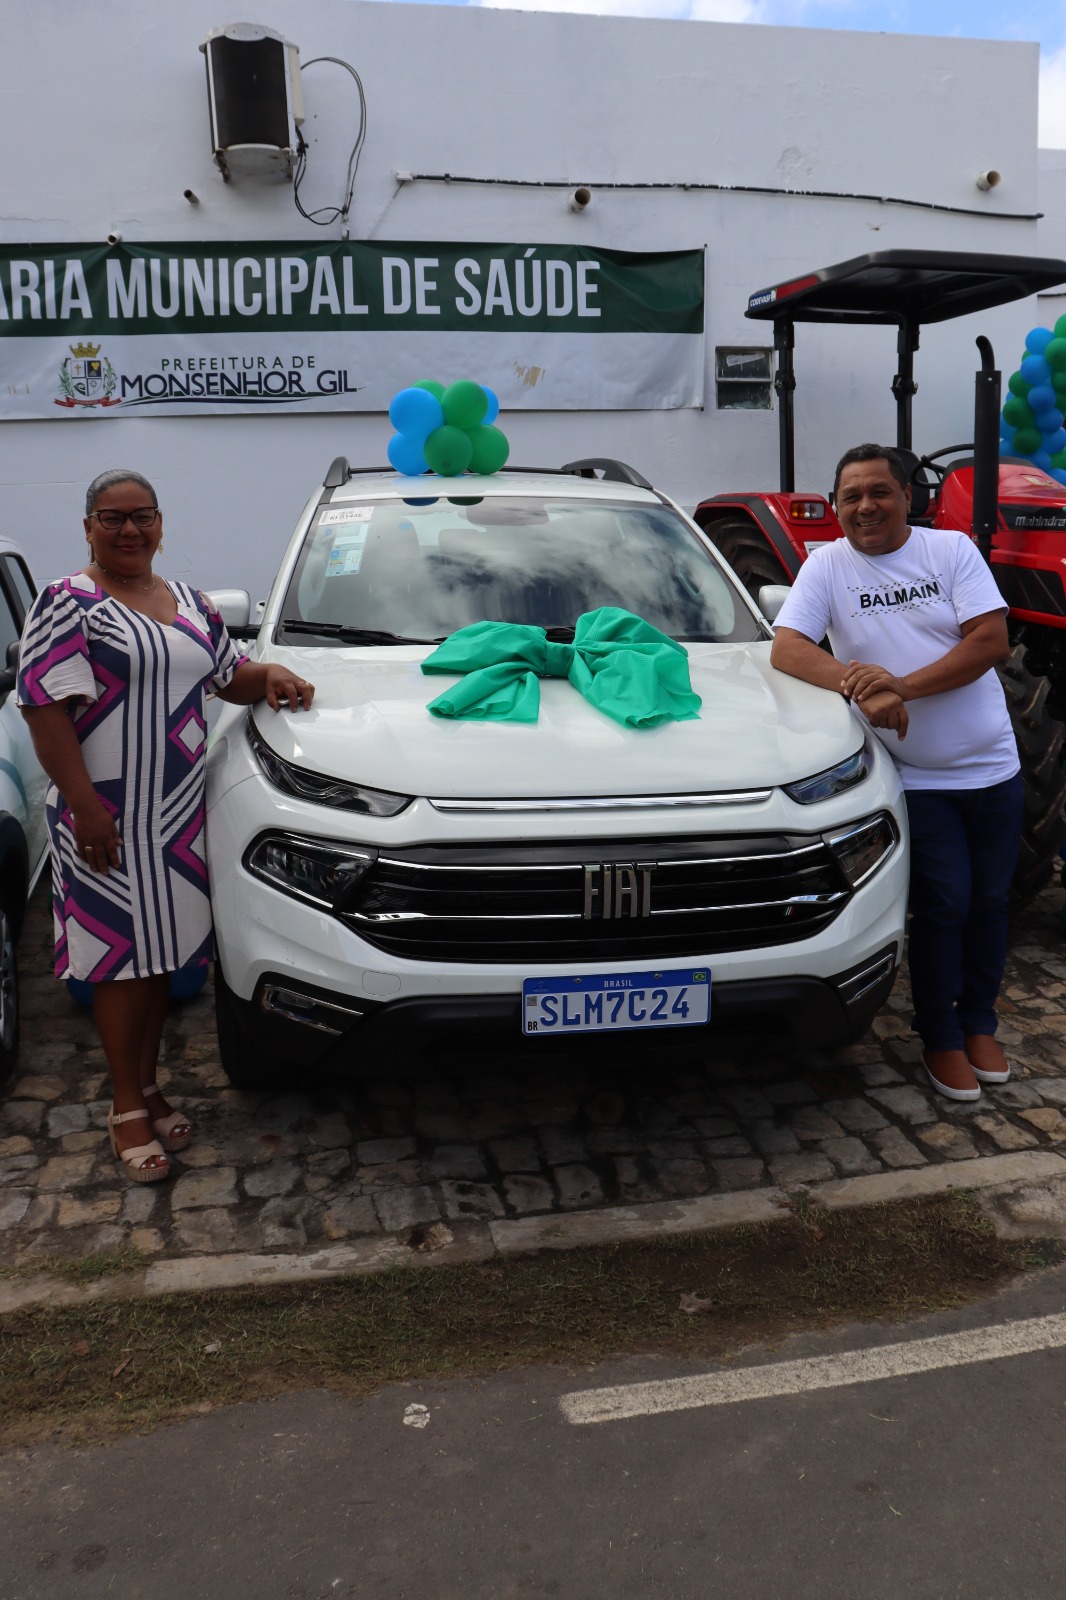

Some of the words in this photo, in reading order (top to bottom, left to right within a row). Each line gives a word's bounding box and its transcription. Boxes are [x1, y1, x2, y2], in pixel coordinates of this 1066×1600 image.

[105, 255, 369, 319] MUNICIPAL
[381, 256, 441, 315] DE
[453, 247, 602, 317] SAÚDE
[161, 355, 284, 371] PREFEITURA
[292, 355, 316, 369] DE
[120, 369, 306, 397] MONSENHOR
[316, 369, 357, 393] GIL
[859, 581, 940, 609] BALMAIN
[583, 862, 657, 920] FIAT
[603, 979, 634, 988] BRASIL
[540, 987, 690, 1027] SLM7C24
[527, 1020, 538, 1031] BR
